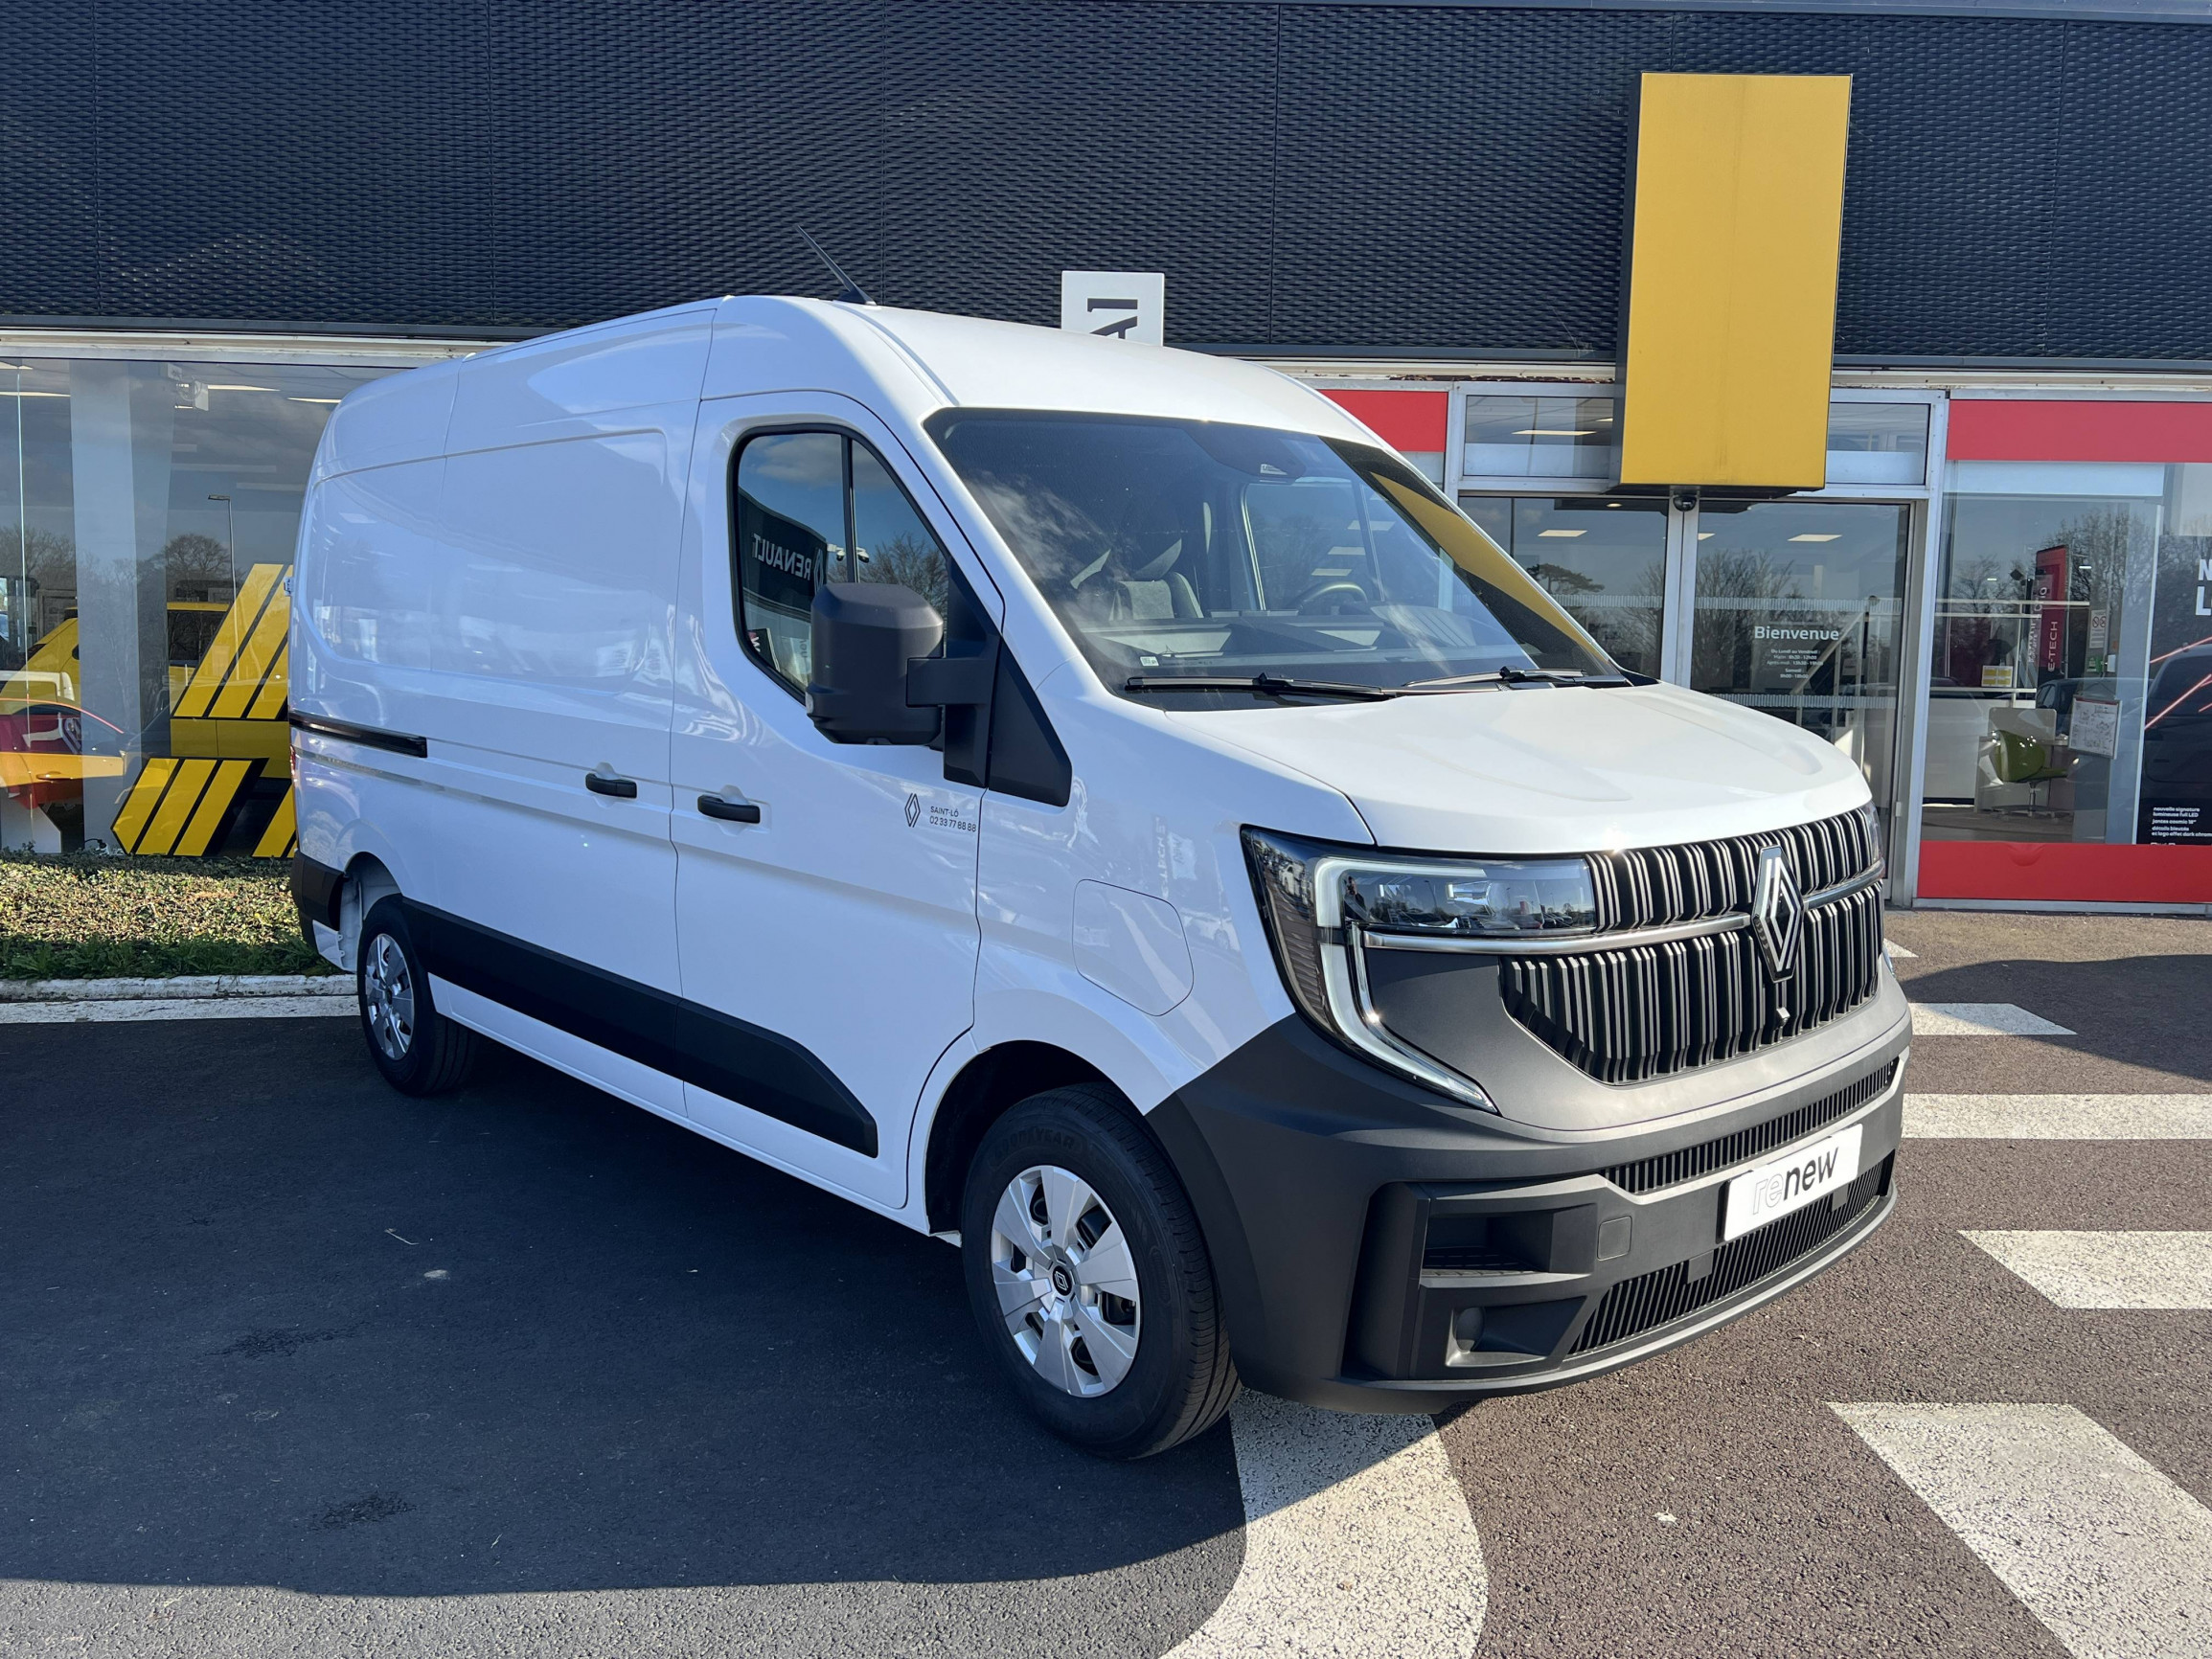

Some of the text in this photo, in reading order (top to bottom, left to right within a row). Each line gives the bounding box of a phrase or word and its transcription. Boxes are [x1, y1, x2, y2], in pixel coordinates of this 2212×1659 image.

[1754, 625, 1839, 641] Bienvenue
[2047, 621, 2058, 671] E-TECH
[929, 815, 977, 832] 02 33 77 88 88
[1753, 1147, 1839, 1216] renew
